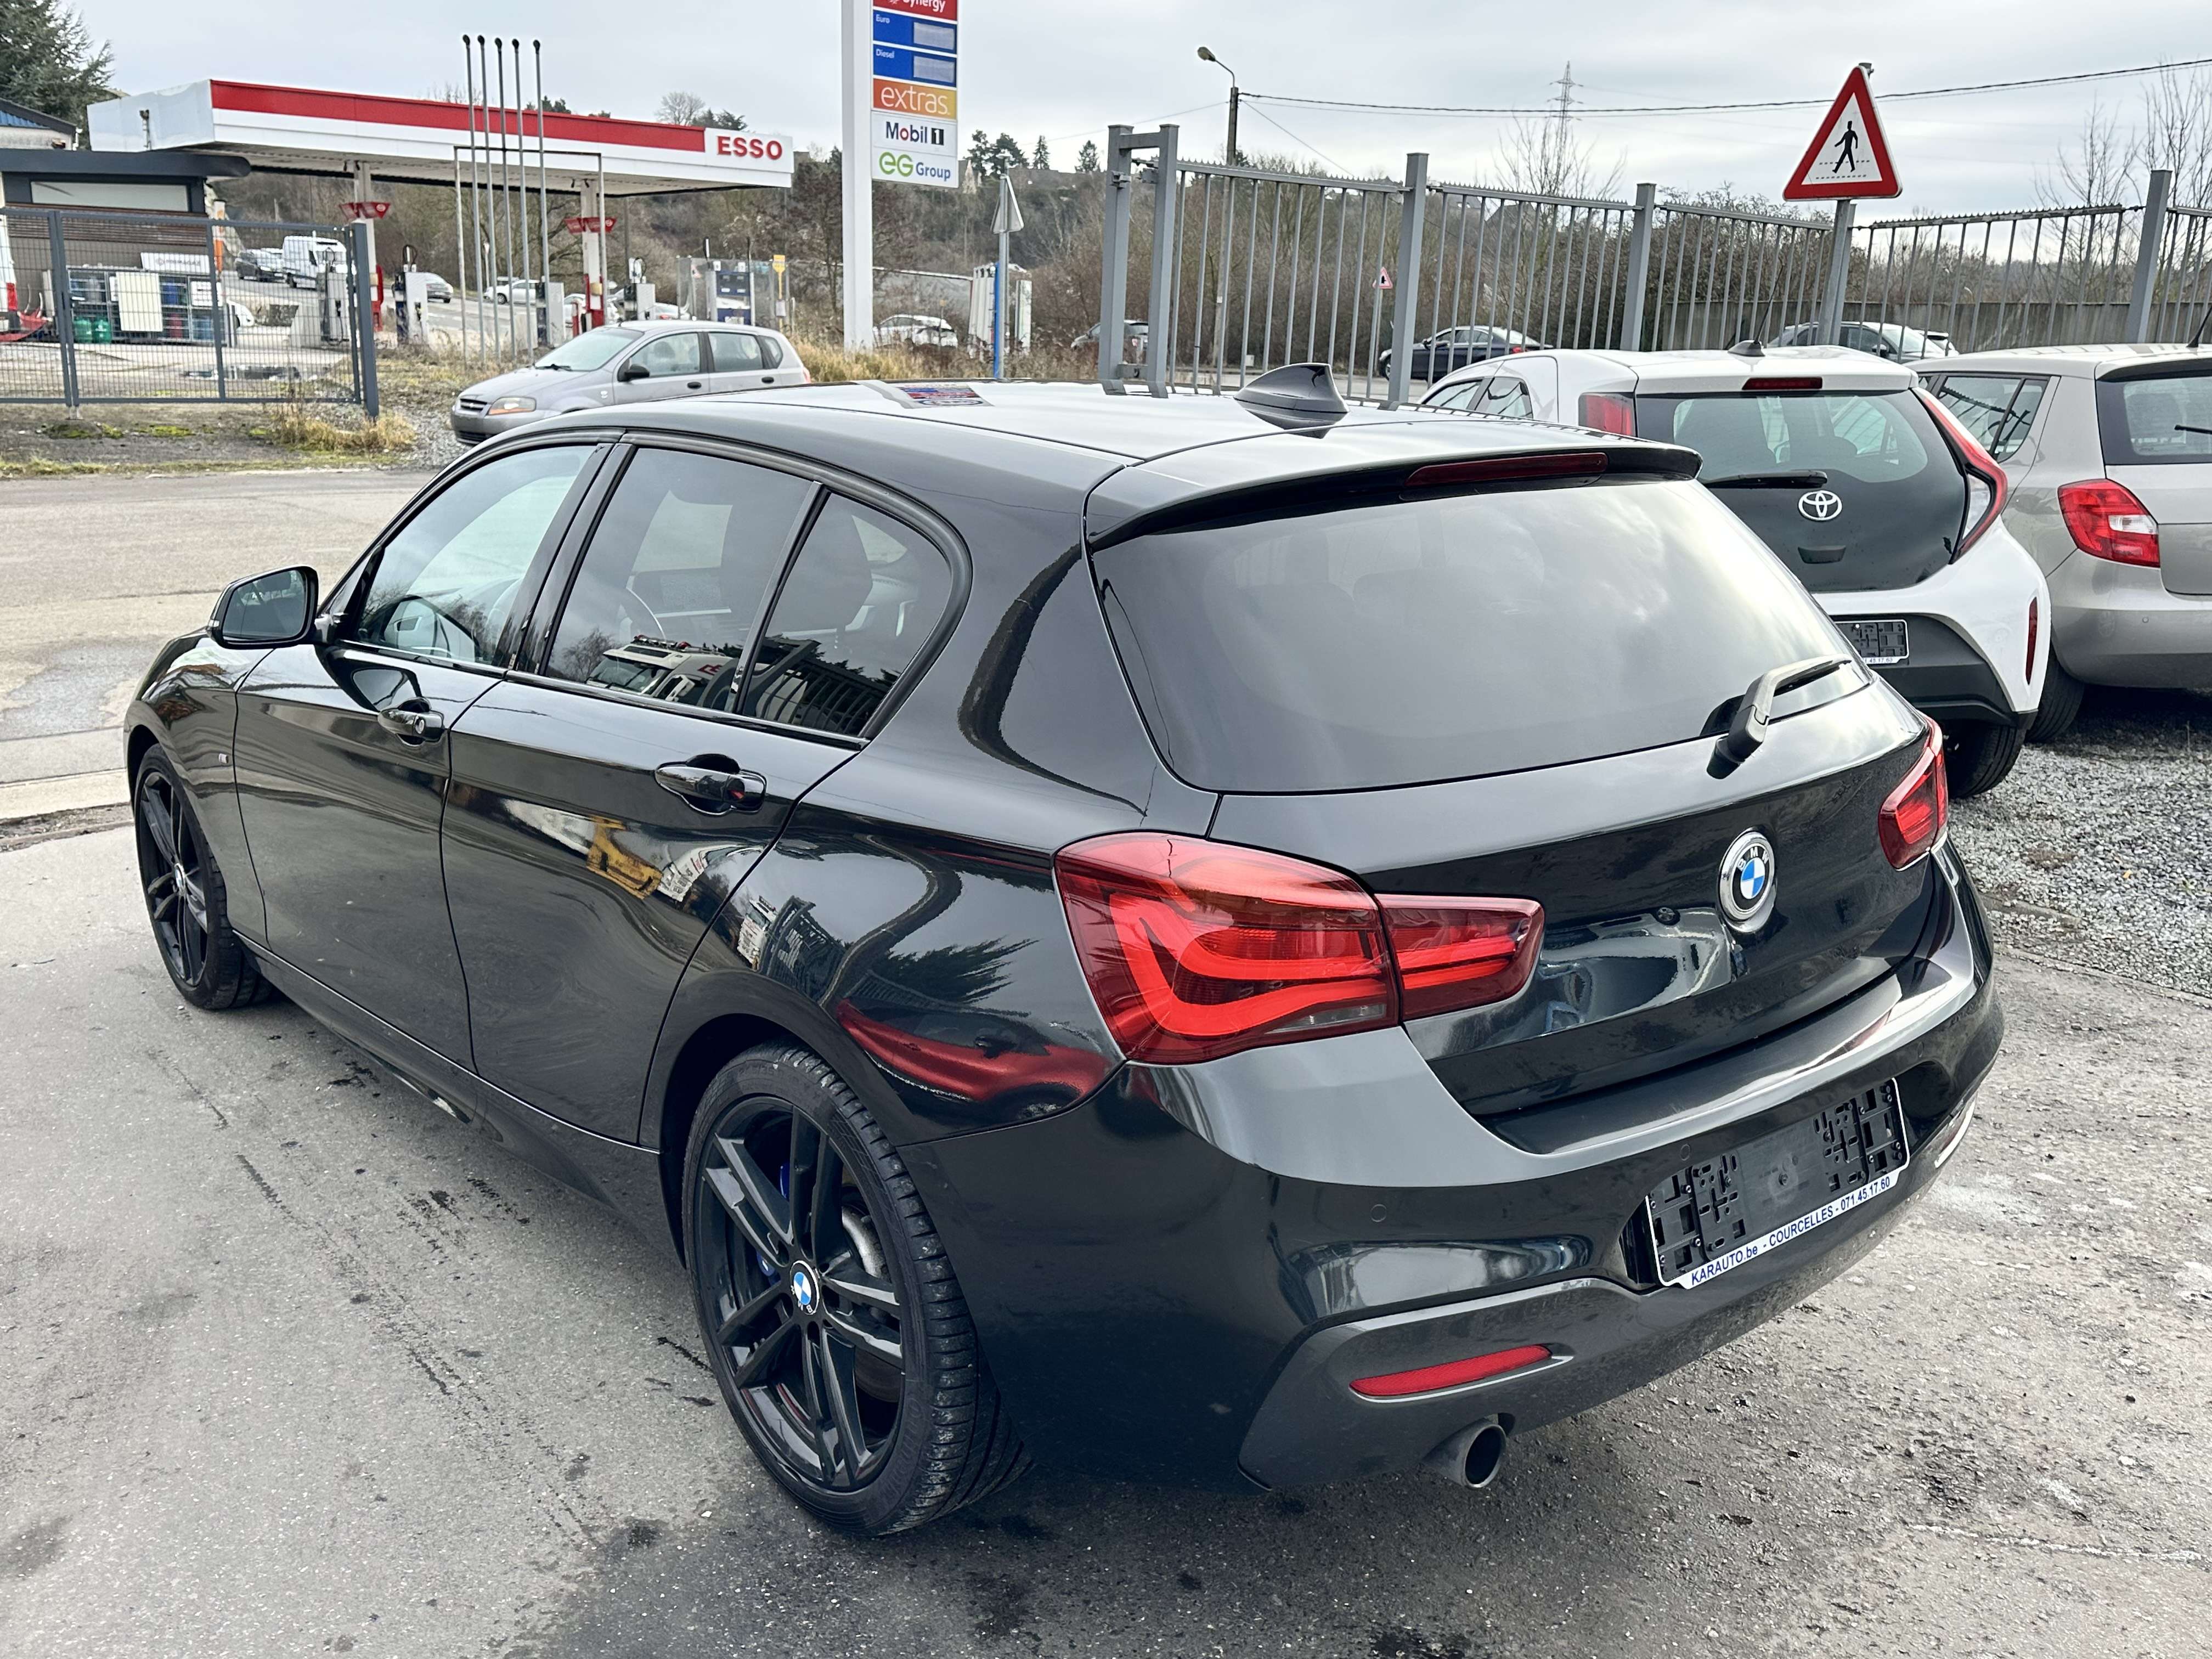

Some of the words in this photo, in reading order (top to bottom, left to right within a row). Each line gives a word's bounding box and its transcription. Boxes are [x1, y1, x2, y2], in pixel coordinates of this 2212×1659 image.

[876, 14, 890, 24] Euro
[876, 49, 895, 59] Diesel
[881, 86, 948, 115] extras
[886, 121, 928, 144] Mobil
[932, 128, 943, 145] 1
[717, 136, 782, 160] ESSO
[916, 162, 950, 181] Group
[1737, 845, 1770, 871] BMW
[1691, 1245, 1758, 1285] KARAUTO.be
[1769, 1205, 1834, 1247] COURCELLES
[1840, 1176, 1891, 1212] 071.45.17.60
